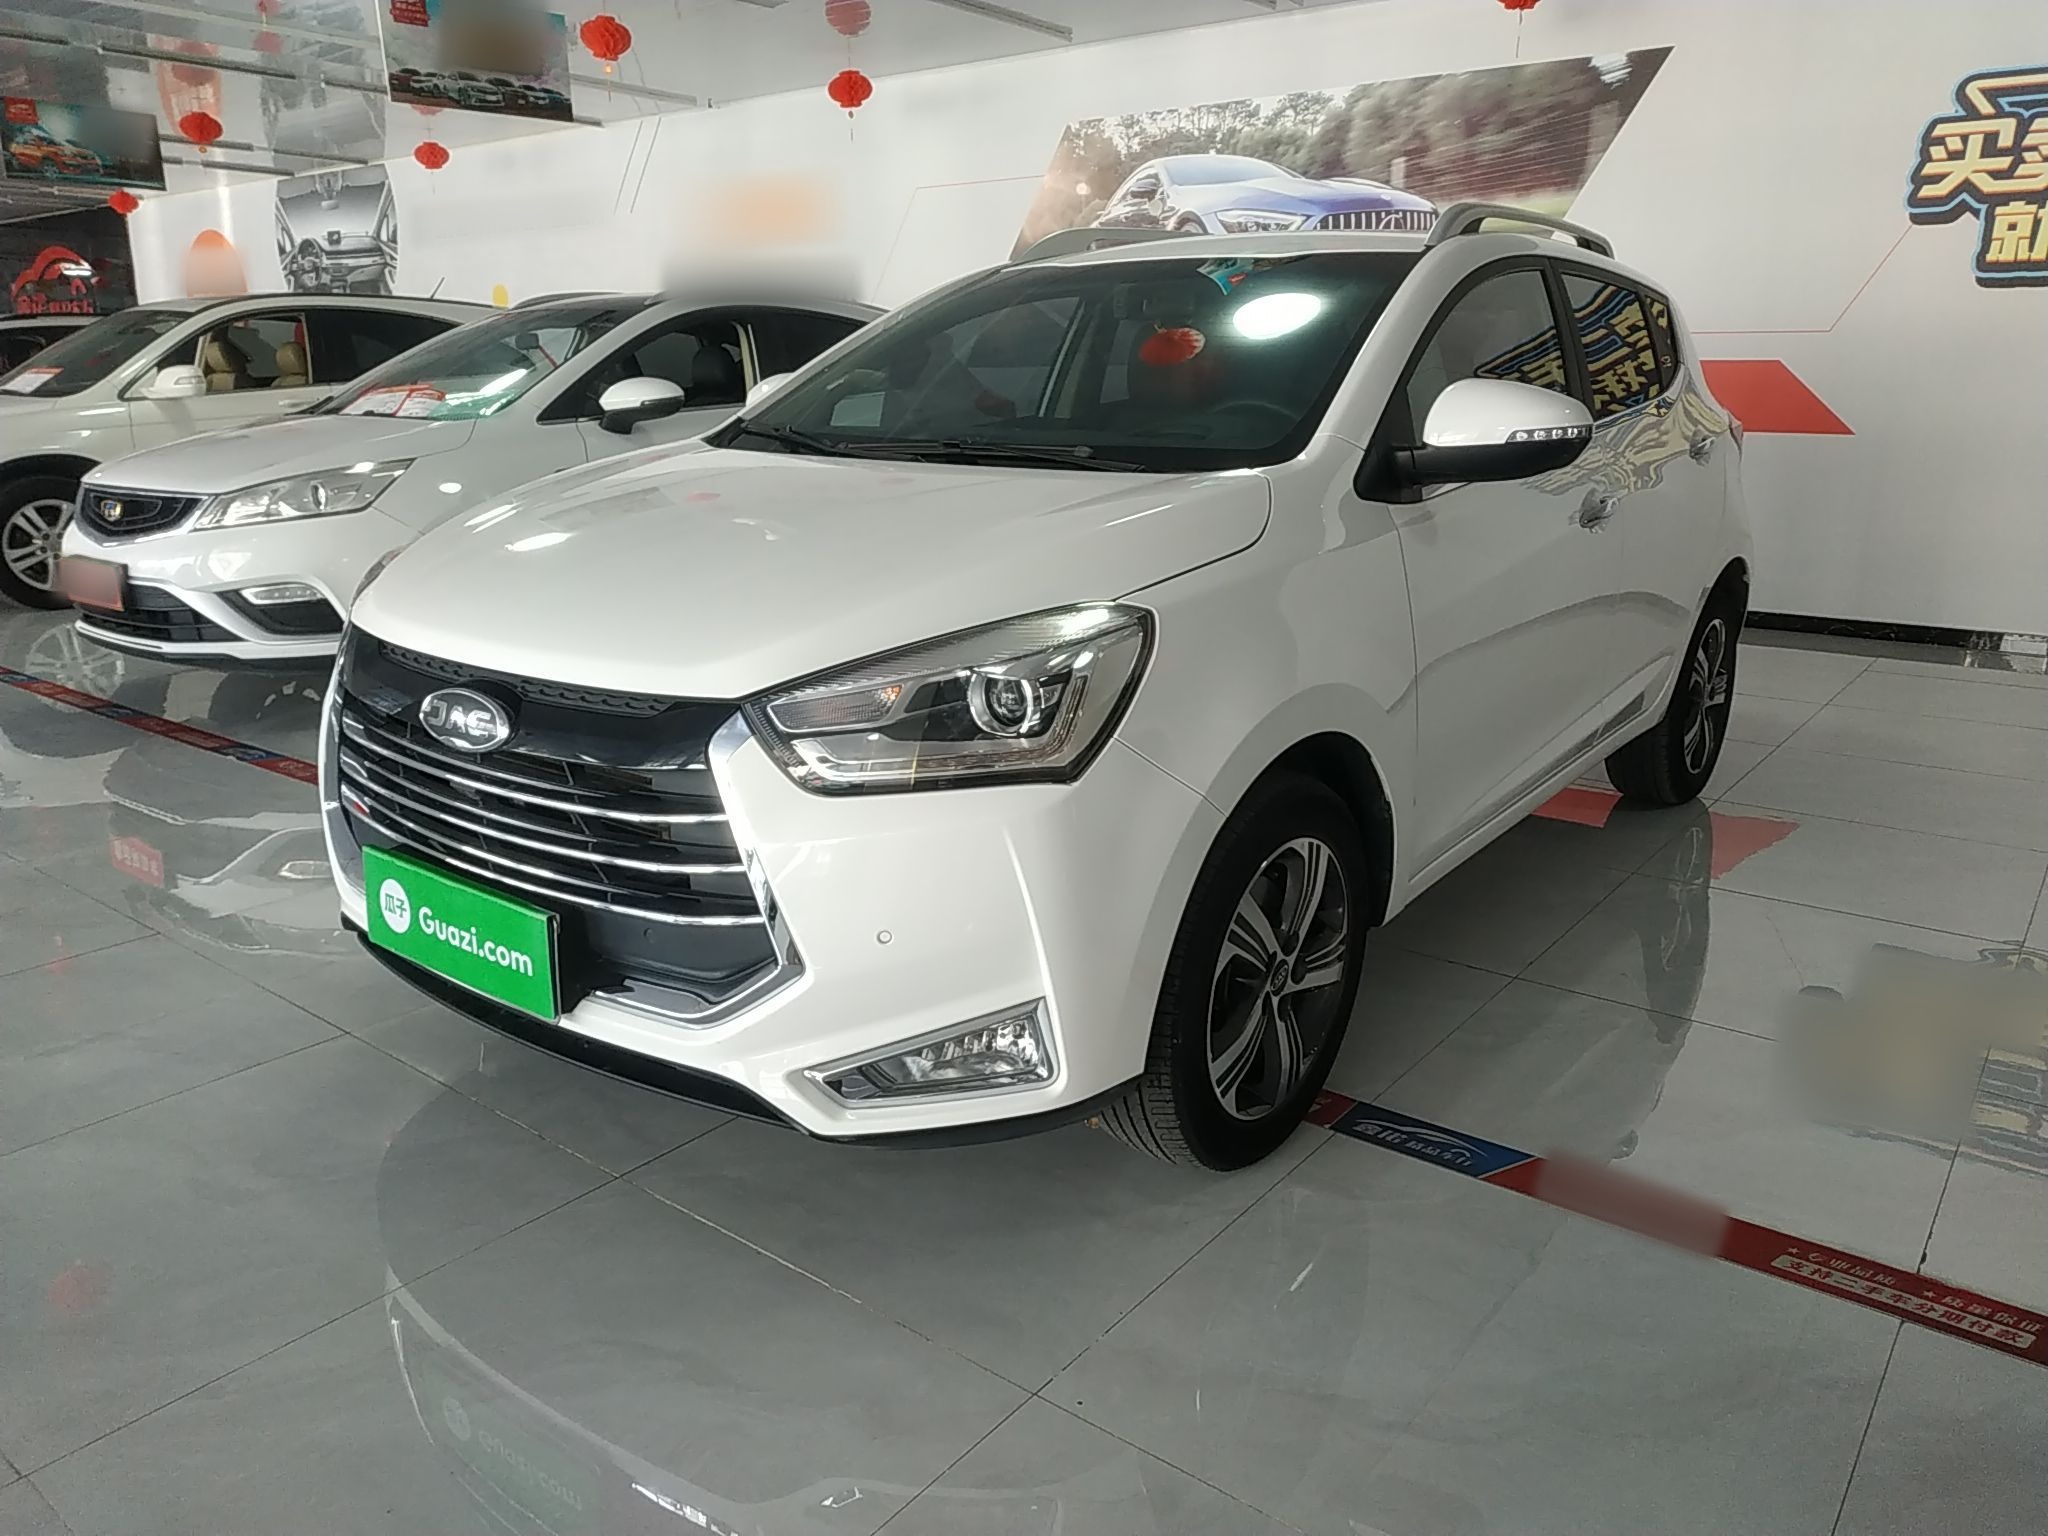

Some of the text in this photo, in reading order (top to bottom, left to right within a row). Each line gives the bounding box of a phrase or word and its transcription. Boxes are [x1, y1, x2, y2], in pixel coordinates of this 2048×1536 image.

[384, 892, 407, 919] 瓜子
[418, 906, 534, 976] Guazi.com
[1786, 1259, 2024, 1343] 支持二手车分期付款
